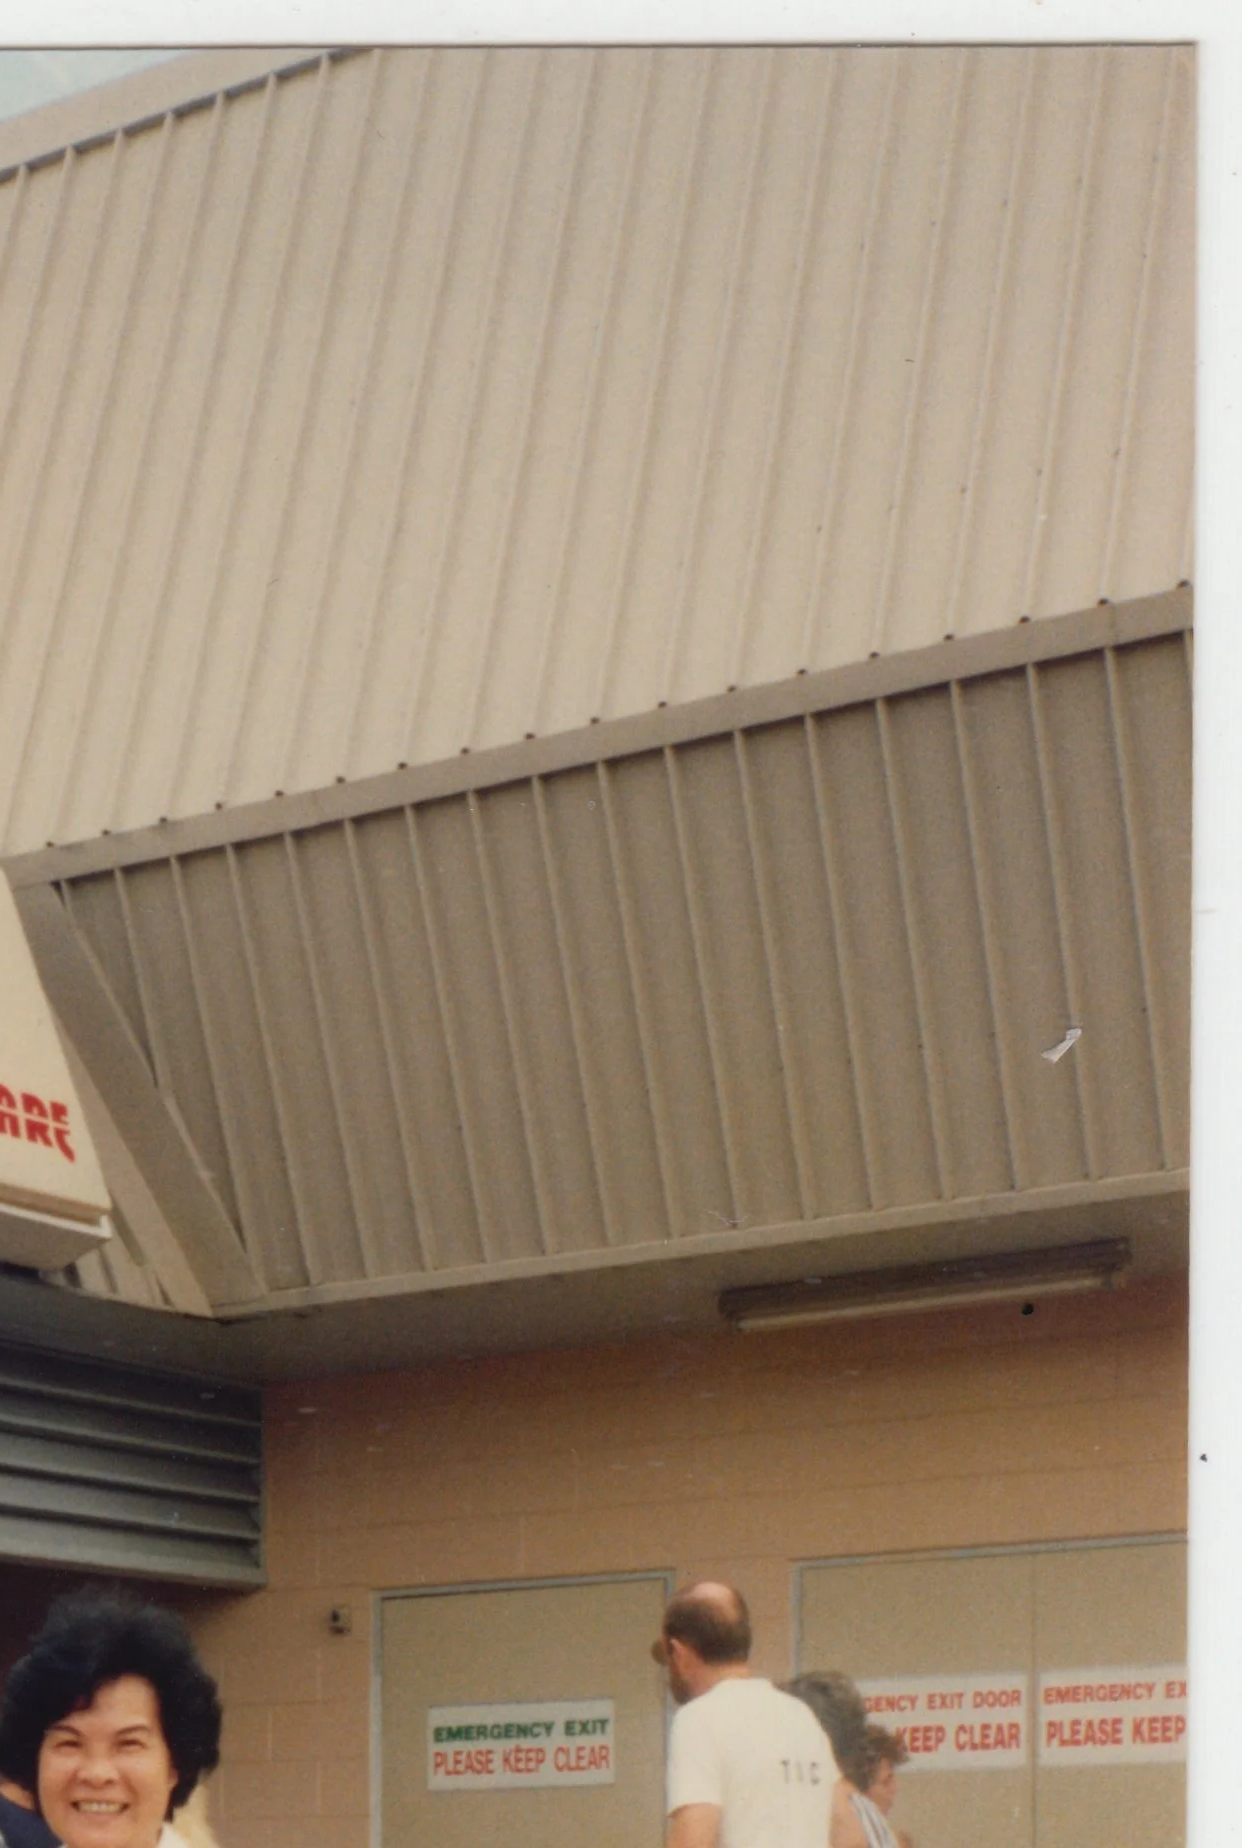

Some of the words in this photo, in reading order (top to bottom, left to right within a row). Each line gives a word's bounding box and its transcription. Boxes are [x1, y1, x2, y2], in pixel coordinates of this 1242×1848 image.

[864, 1694, 919, 1713] GENCY
[926, 1692, 965, 1709] EXIT
[972, 1689, 1022, 1708] DOOR
[1043, 1681, 1156, 1705] EMERGENCY
[1164, 1680, 1187, 1699] EX
[433, 1720, 555, 1743] EMERGENCY
[564, 1718, 610, 1736] EXIT
[954, 1722, 1021, 1751] CLEAR
[1045, 1716, 1123, 1747] PLEASE
[1131, 1715, 1186, 1744] KEEP
[433, 1749, 495, 1776] PLEASE
[503, 1745, 546, 1773] KEEP
[554, 1745, 611, 1772] CLEAR
